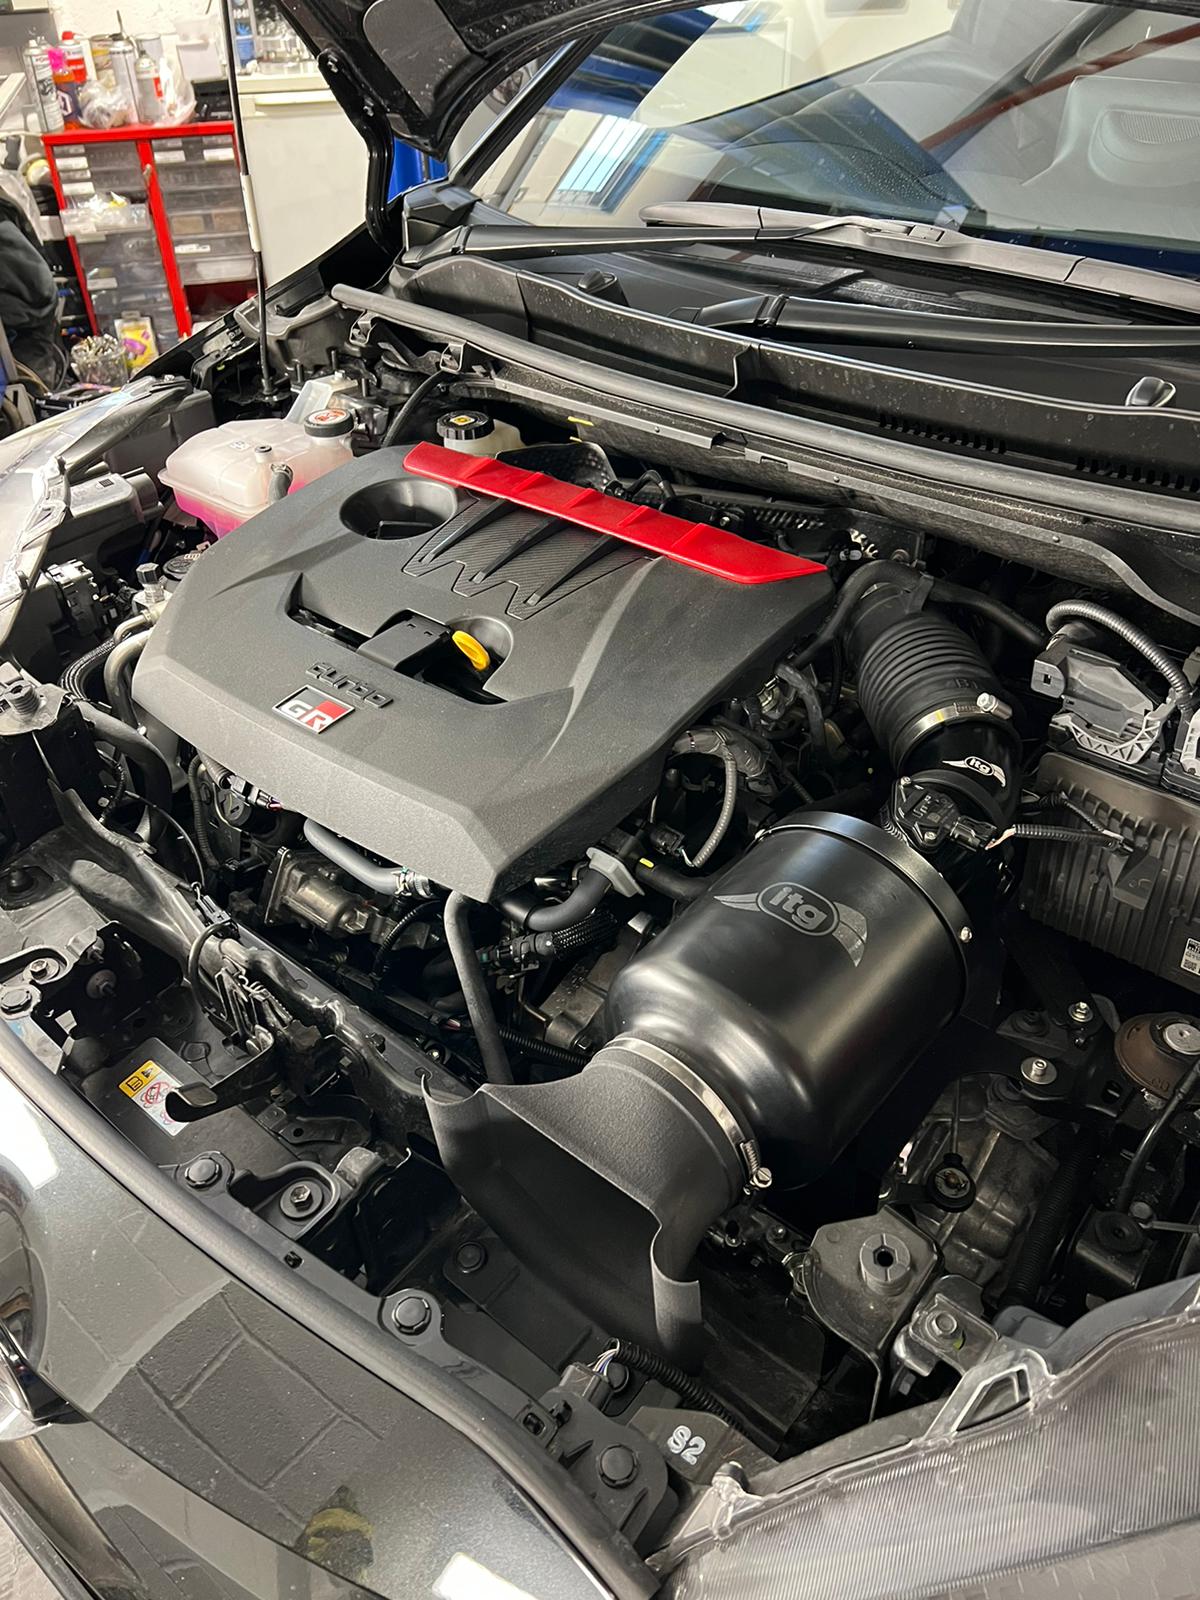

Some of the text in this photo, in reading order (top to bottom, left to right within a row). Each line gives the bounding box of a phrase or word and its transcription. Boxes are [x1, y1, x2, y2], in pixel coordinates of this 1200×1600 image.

[279, 699, 335, 731] GR
[968, 758, 992, 775] itg
[769, 886, 828, 930] itg
[667, 1425, 706, 1465] S2
